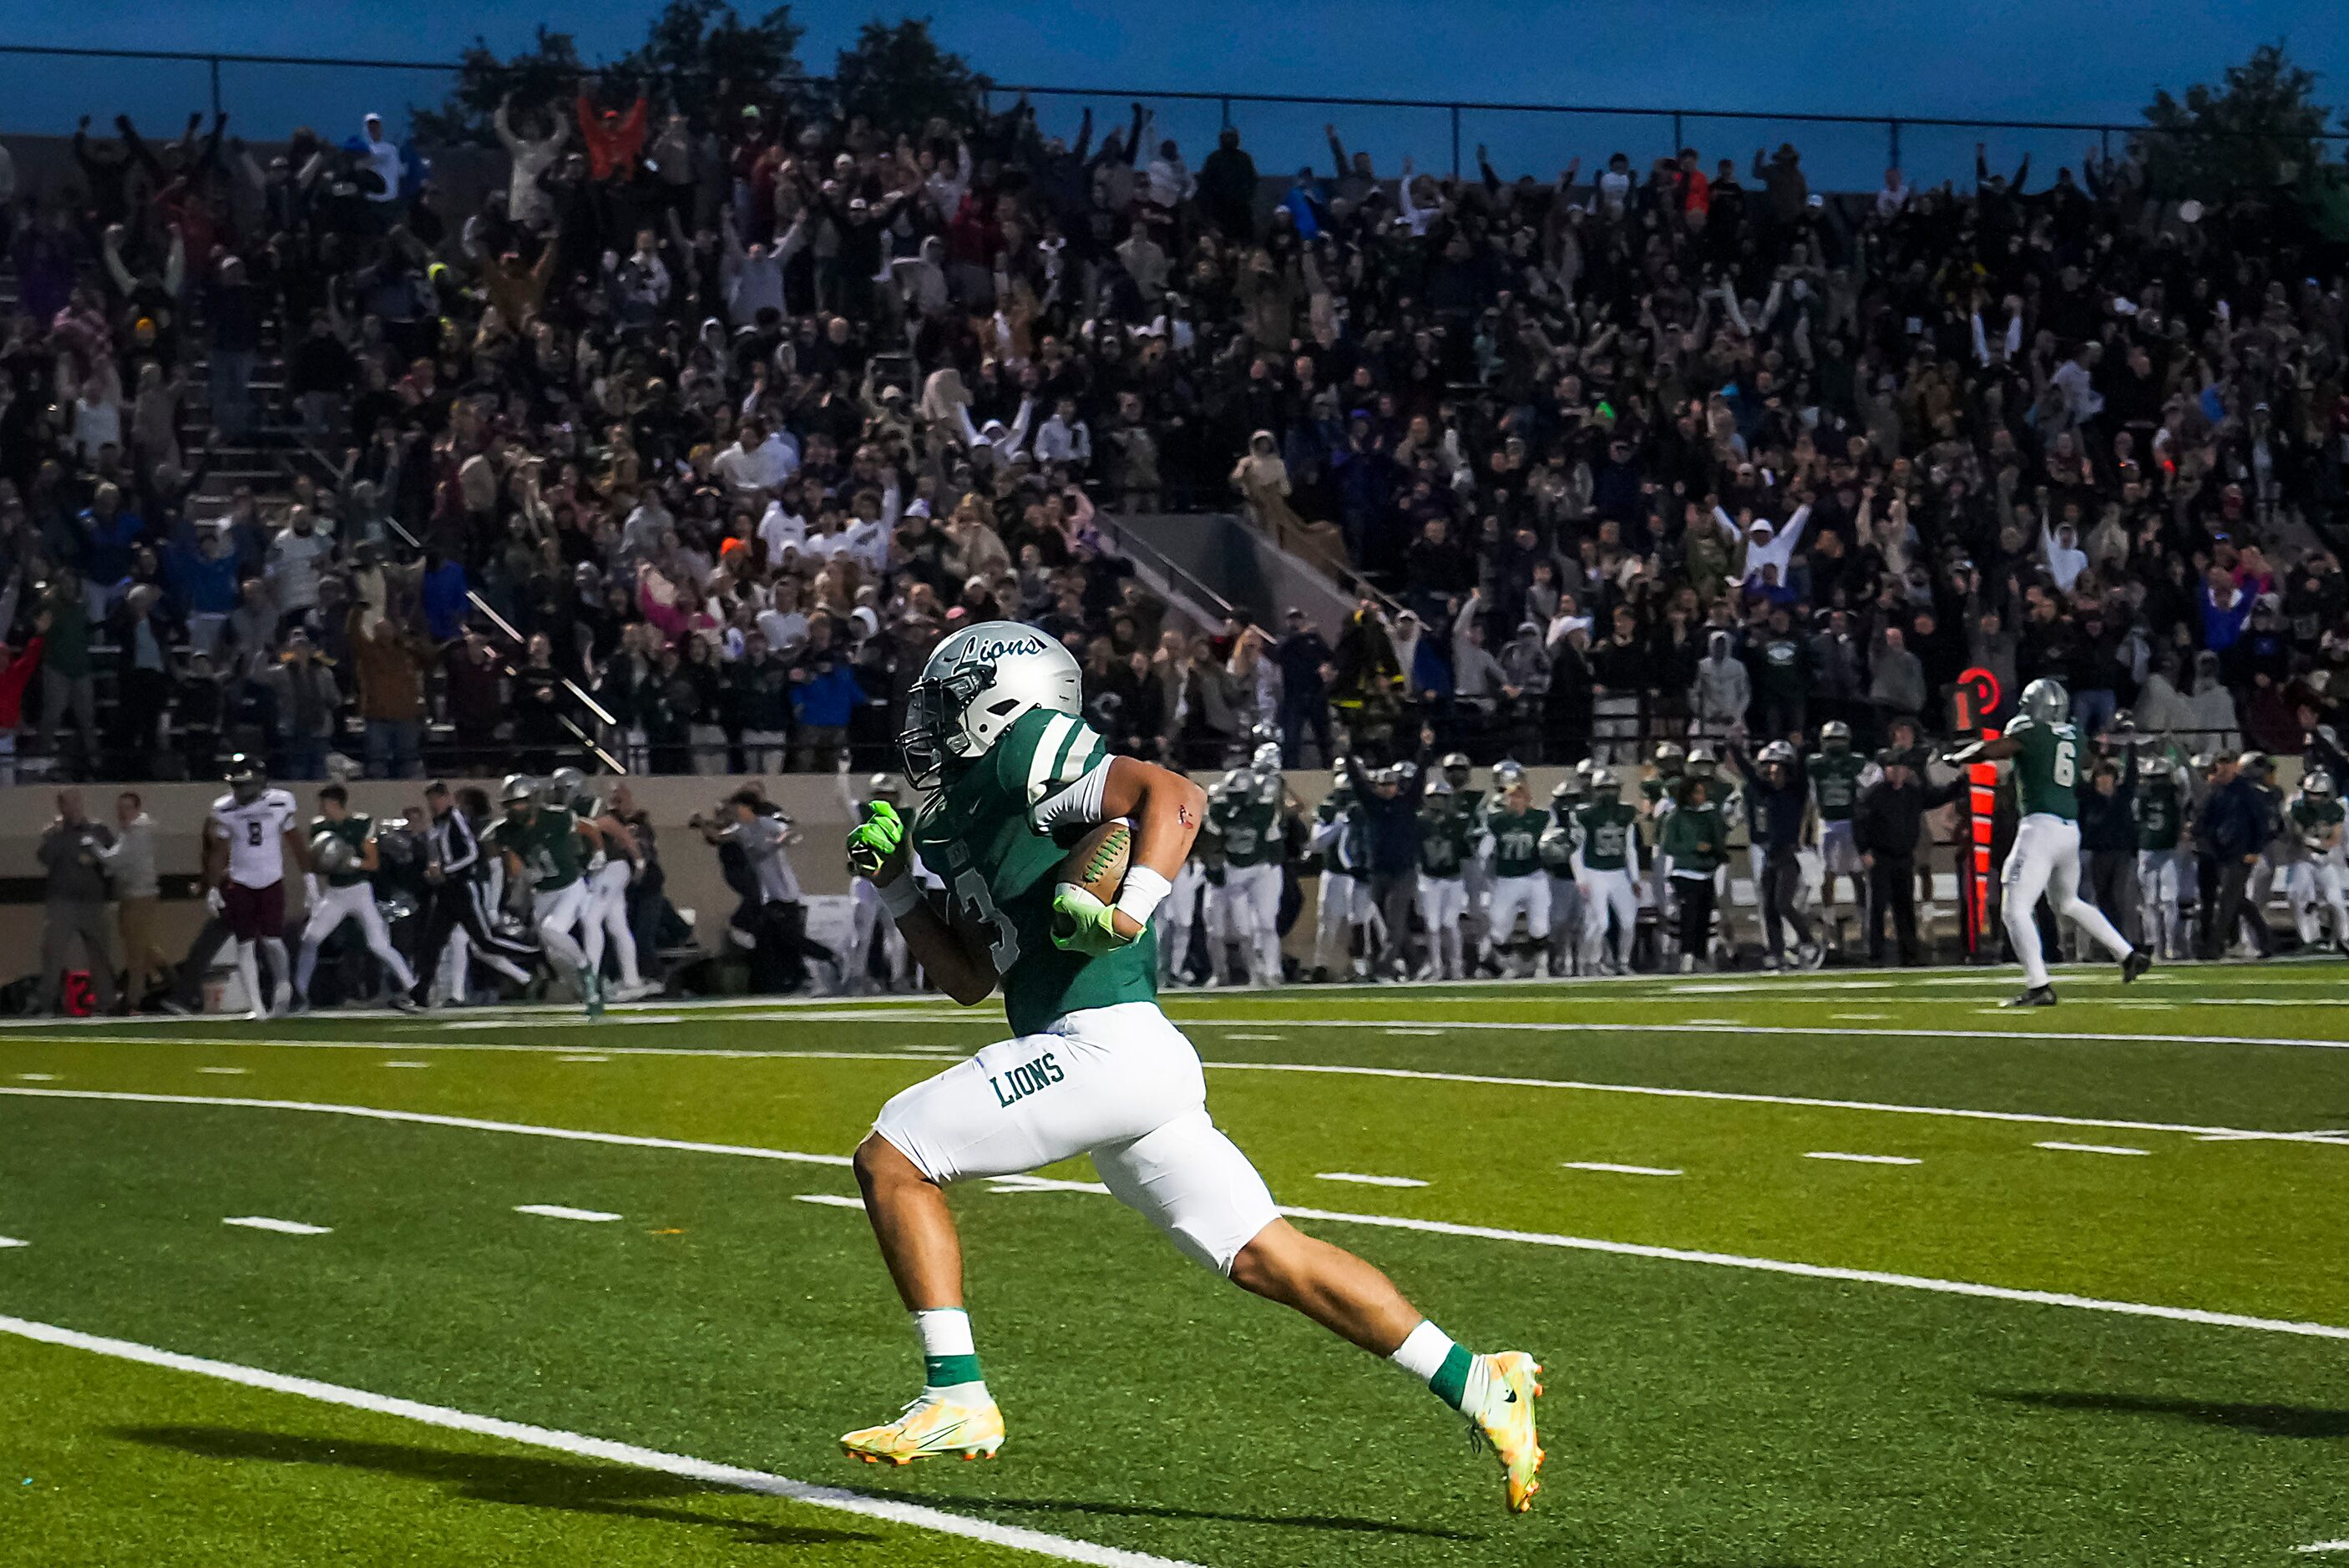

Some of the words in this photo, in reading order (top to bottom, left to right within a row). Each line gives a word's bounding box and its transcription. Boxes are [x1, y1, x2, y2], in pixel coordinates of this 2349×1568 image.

[958, 635, 1040, 665] Lions
[2053, 740, 2077, 787] 6
[248, 822, 262, 846] 8
[989, 1052, 1065, 1109] LIONS
